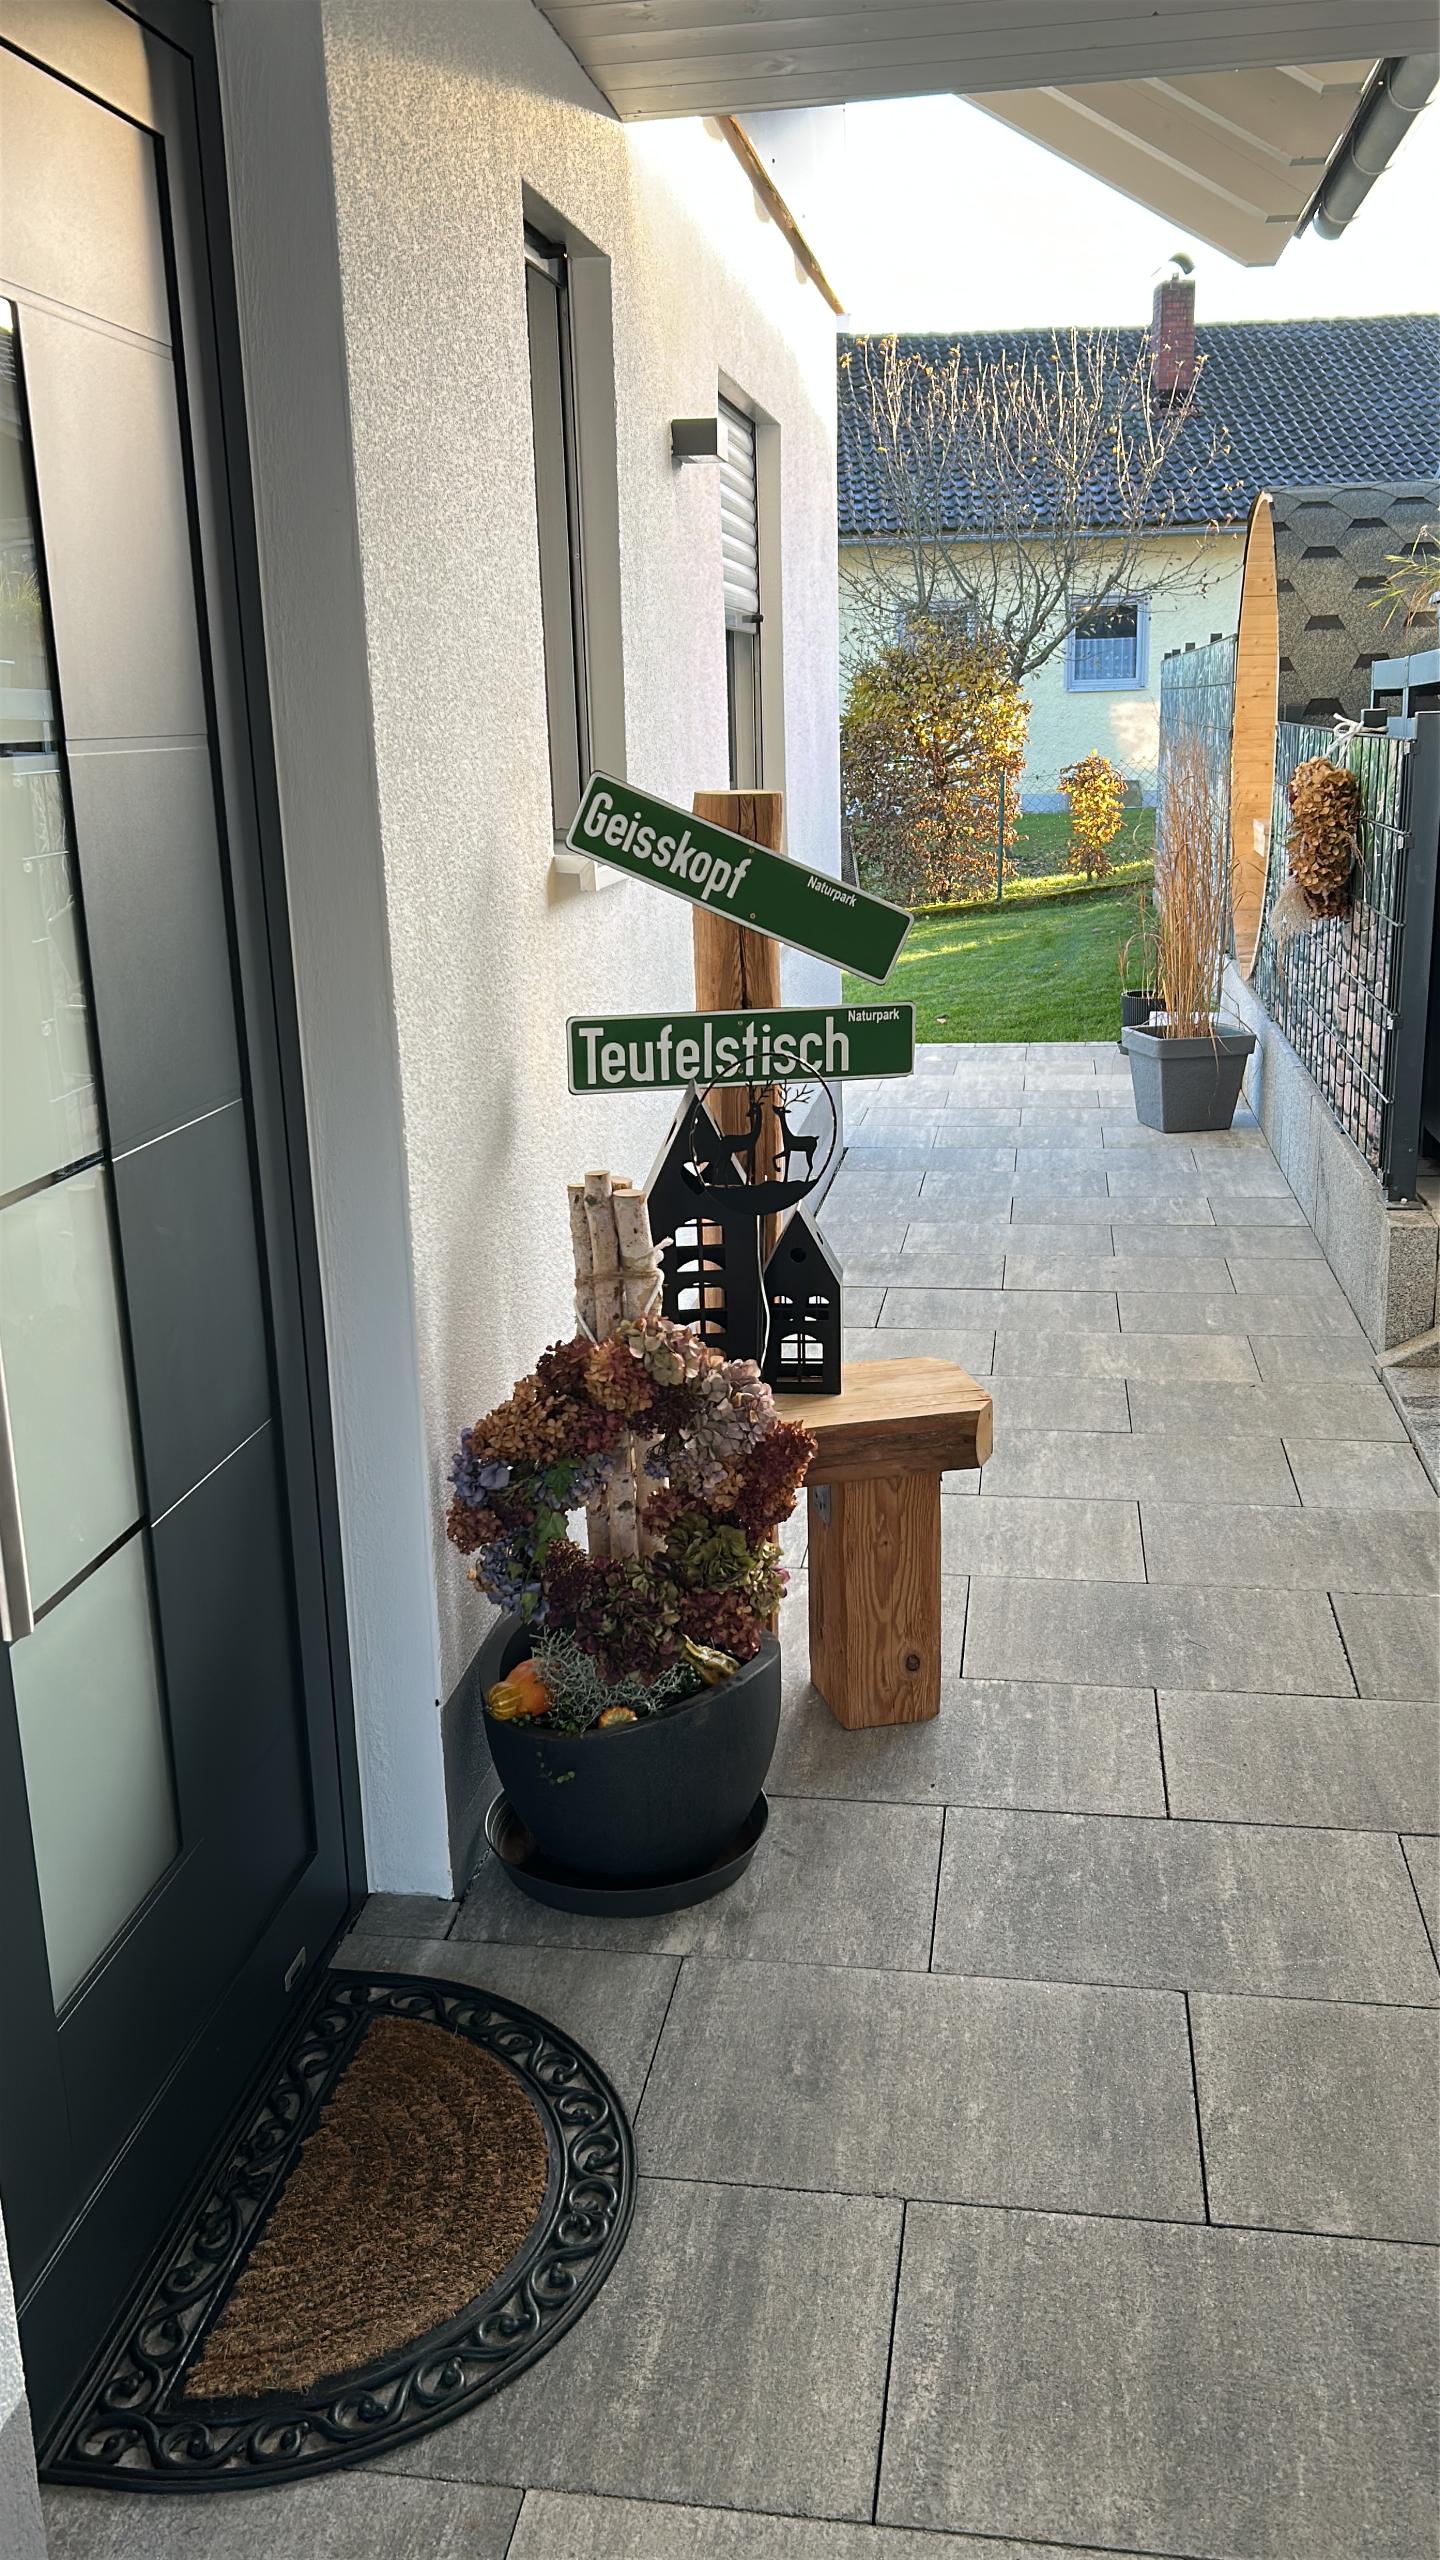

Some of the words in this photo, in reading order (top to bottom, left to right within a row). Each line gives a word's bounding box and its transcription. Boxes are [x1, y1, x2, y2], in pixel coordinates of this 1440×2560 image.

[583, 792, 752, 900] Geisskopf
[807, 876, 857, 908] Naturpark
[848, 1008, 900, 1023] Naturpark
[579, 1016, 850, 1085] Teufelstisch
